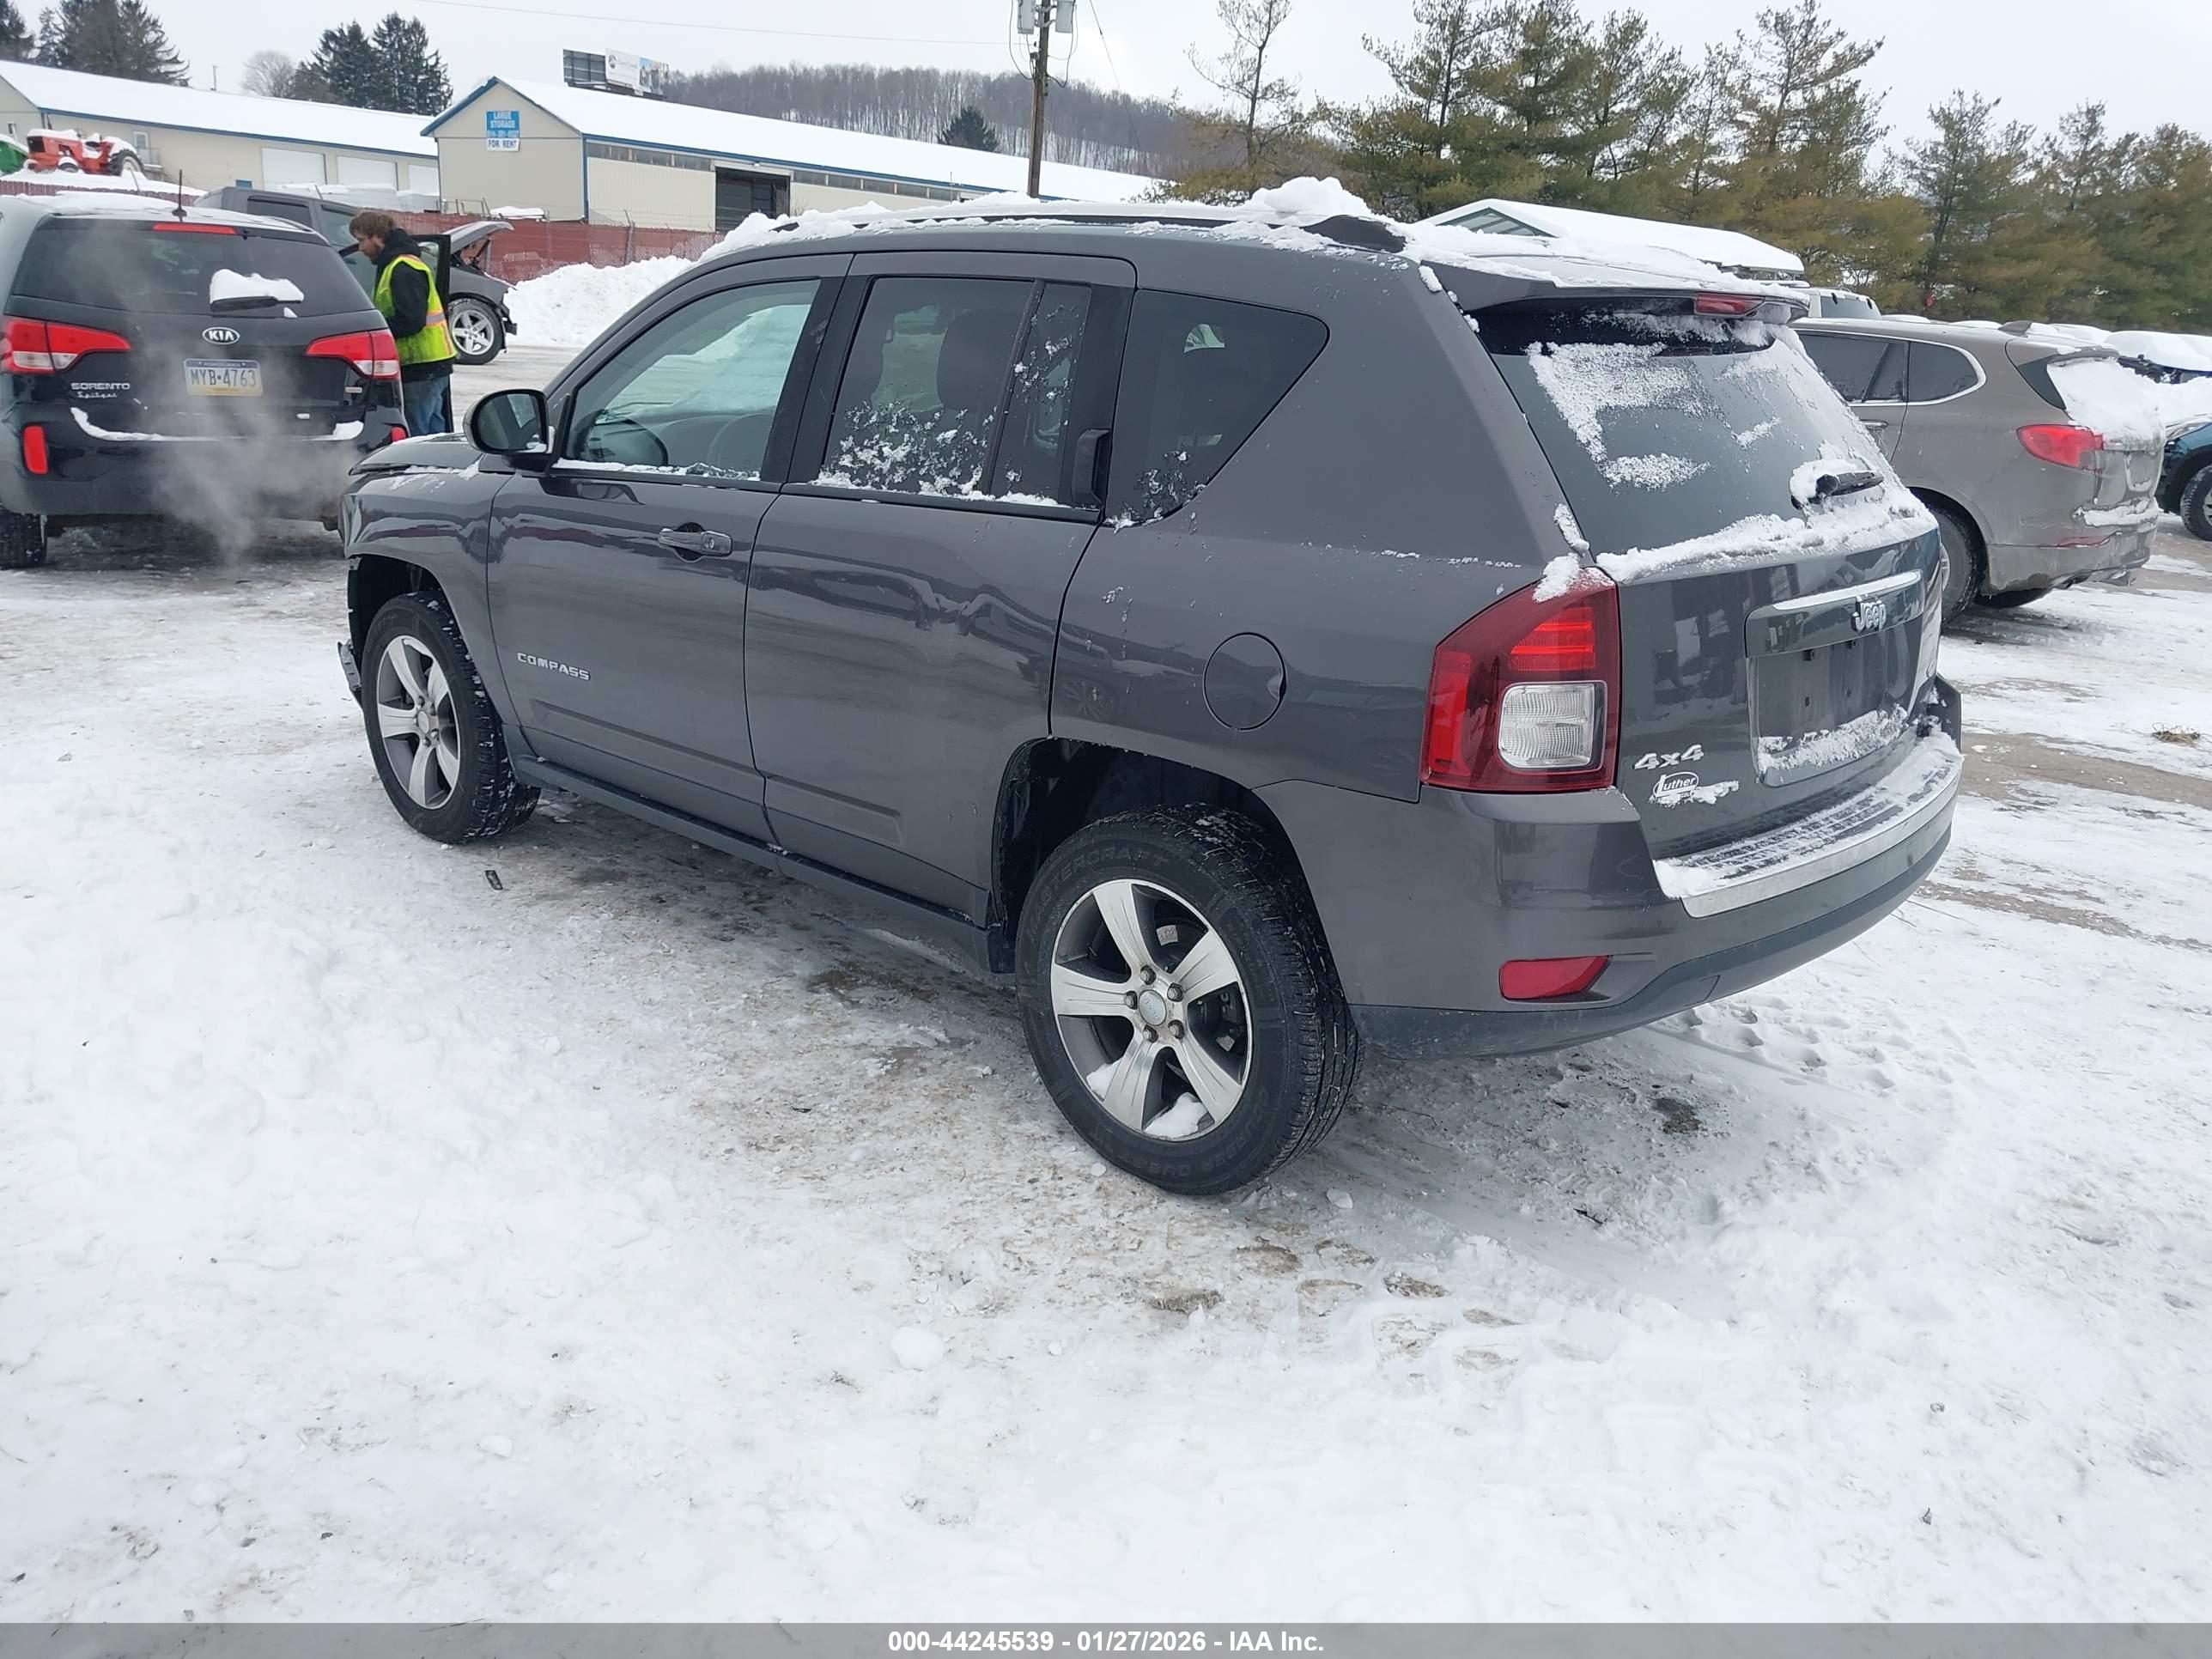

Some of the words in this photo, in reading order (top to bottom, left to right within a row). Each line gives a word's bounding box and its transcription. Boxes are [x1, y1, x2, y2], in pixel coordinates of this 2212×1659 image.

[488, 139, 500, 149] FOR
[502, 139, 517, 149] RENT
[208, 330, 234, 342] KIA
[70, 382, 130, 391] SORENTO
[1855, 602, 1887, 631] Jeep
[517, 652, 590, 681] COMPASS
[1655, 774, 1698, 799] Luther
